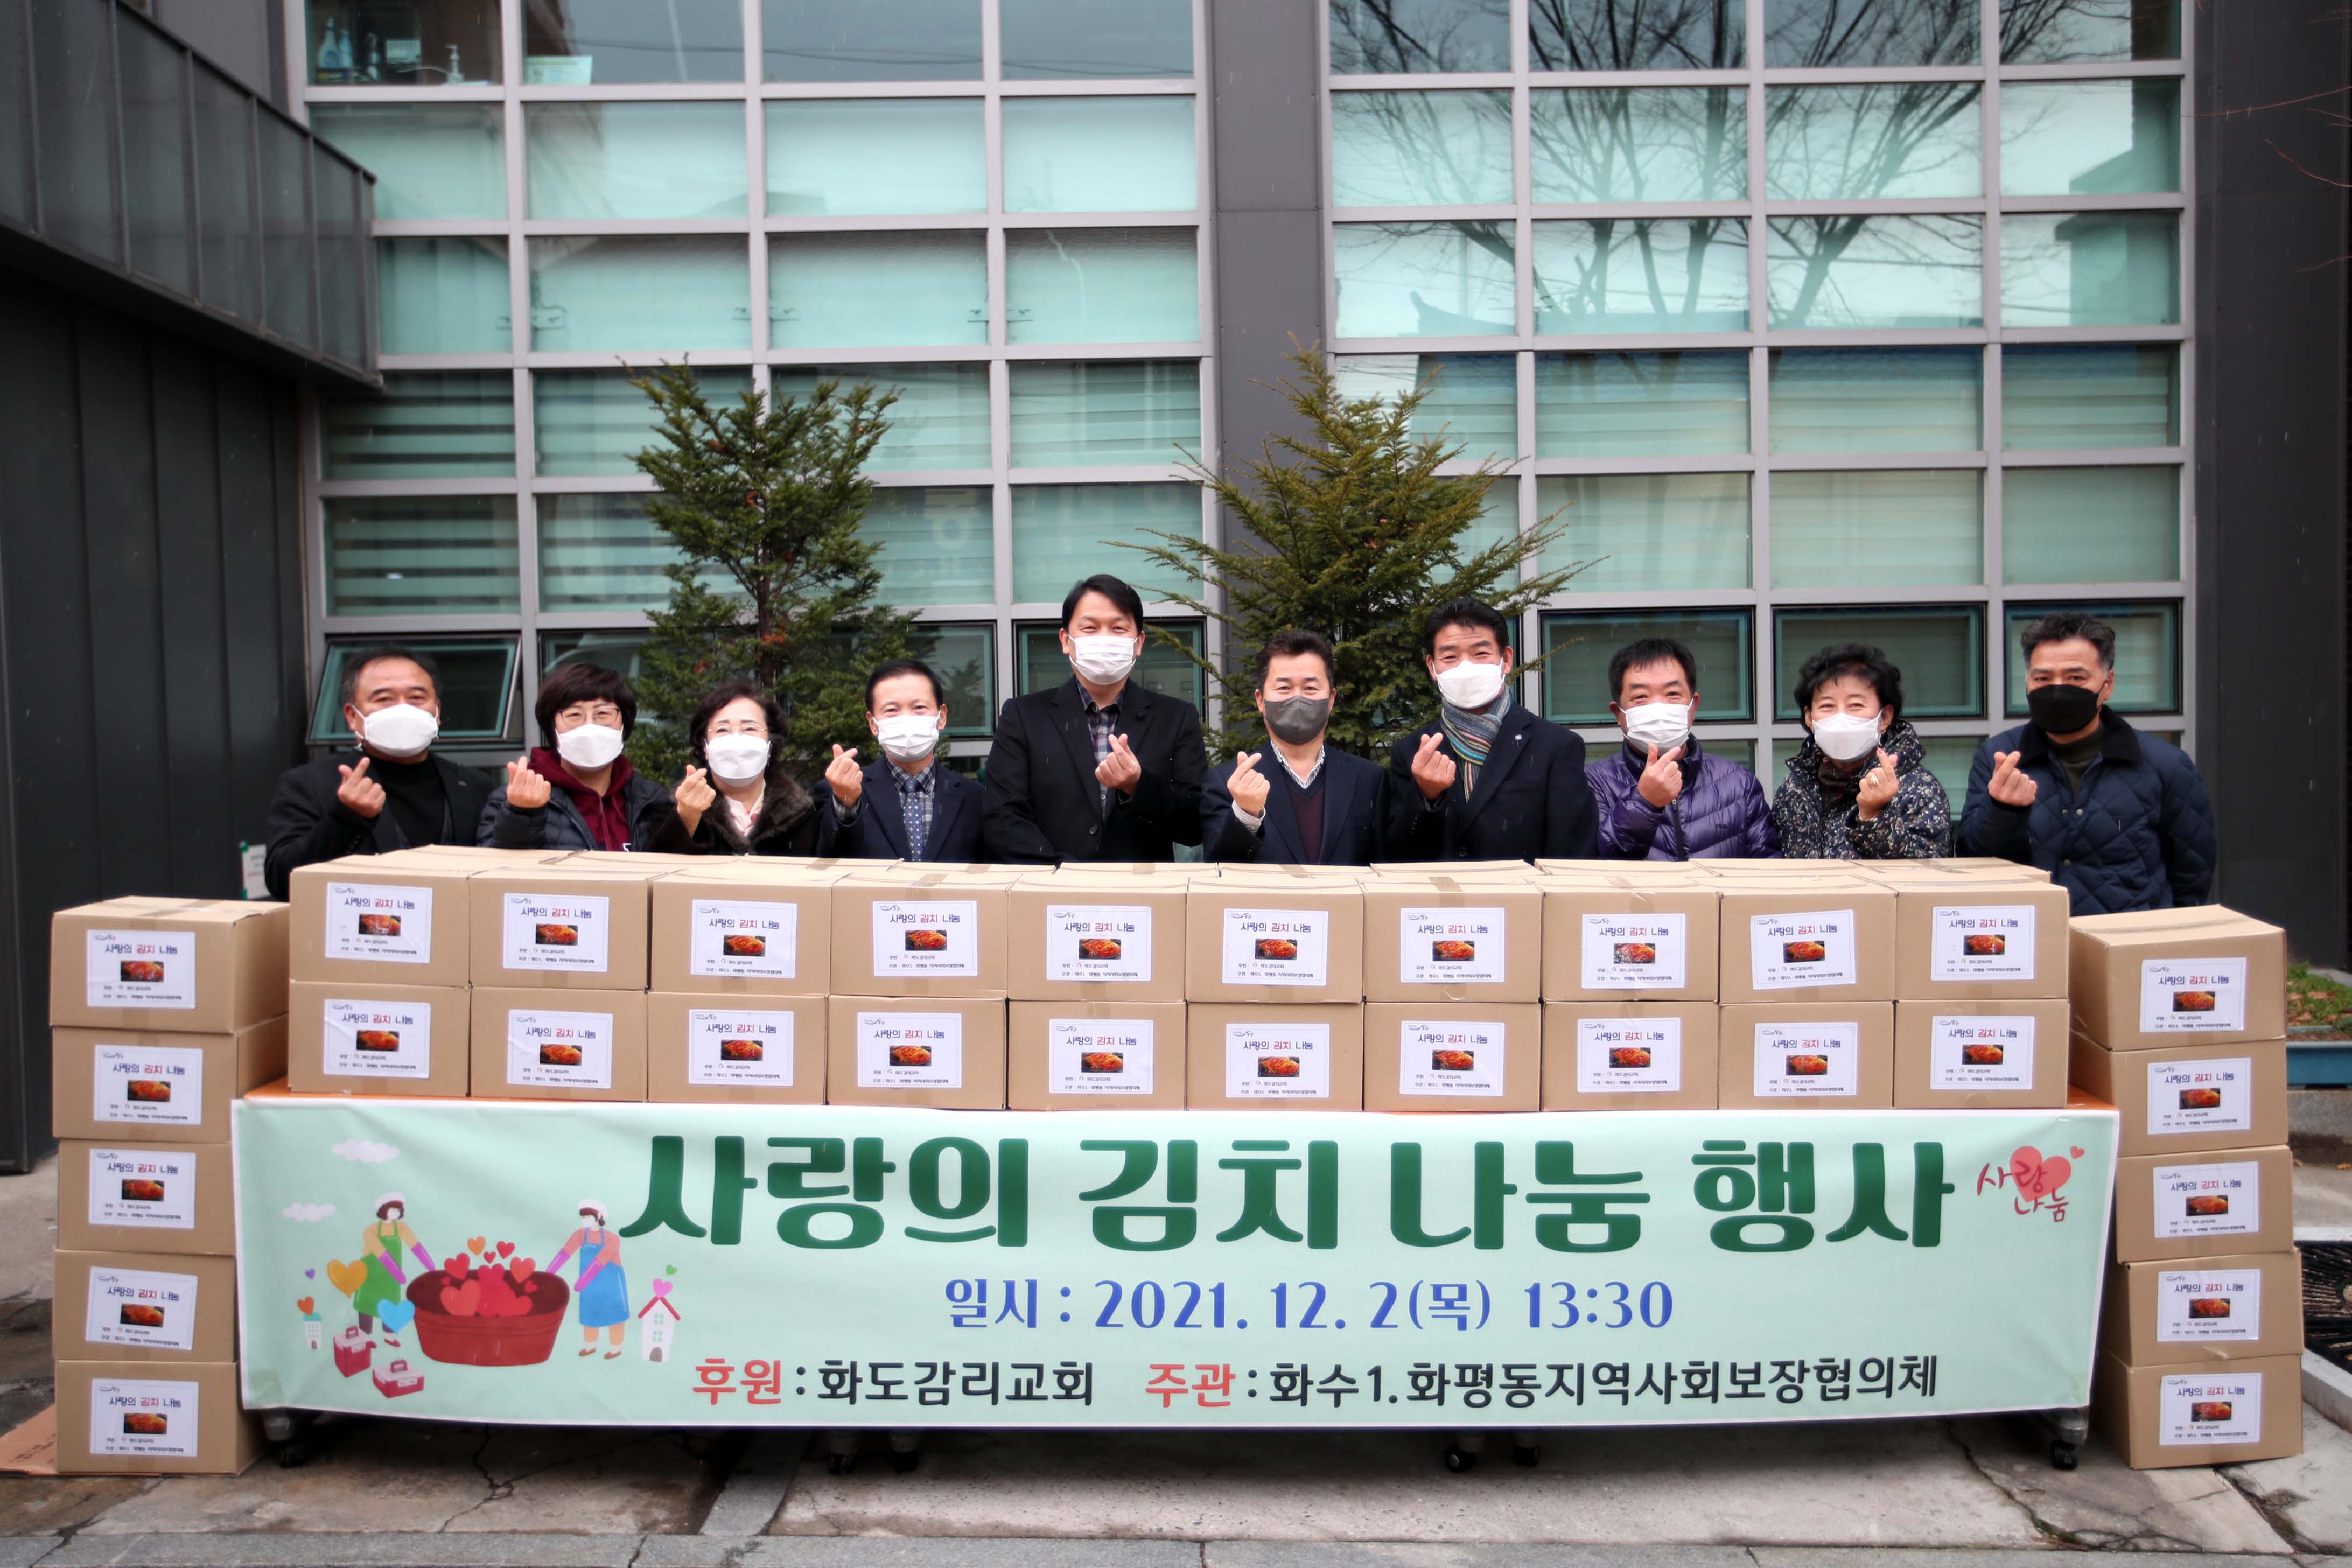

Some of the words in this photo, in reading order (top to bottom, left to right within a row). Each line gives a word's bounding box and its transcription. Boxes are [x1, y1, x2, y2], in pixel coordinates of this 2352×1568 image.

[345, 897, 370, 907] 사랑의
[375, 899, 393, 908] 김치
[397, 900, 415, 909] 나눔
[521, 907, 547, 917] 사랑의
[552, 908, 569, 918] 김치
[575, 909, 592, 918] 나눔
[890, 914, 915, 923] 사랑의
[921, 914, 937, 923] 김치
[943, 914, 960, 923] 나눔
[1949, 919, 1975, 928] 사랑의
[1979, 919, 1996, 928] 김치
[2001, 919, 2018, 927] 나눔
[709, 919, 735, 928] 사랑의
[740, 920, 757, 928] 김치
[762, 920, 779, 929] 나눔
[1064, 923, 1090, 932] 사랑의
[1095, 923, 1112, 932] 김치
[1117, 923, 1135, 932] 나눔
[1241, 922, 1266, 932] 사랑의
[1272, 923, 1289, 932] 김치
[1293, 924, 1311, 933] 나눔
[1418, 925, 1443, 934] 사랑의
[1448, 925, 1465, 934] 김치
[1471, 925, 1488, 933] 나눔
[1599, 927, 1625, 936] 사랑의
[1630, 927, 1647, 936] 김치
[1651, 927, 1668, 936] 나눔
[1768, 926, 1793, 936] 사랑의
[1798, 925, 1815, 935] 김치
[1820, 924, 1837, 933] 나눔
[106, 944, 132, 954] 사랑의
[137, 944, 155, 954] 김치
[159, 946, 178, 954] 나눔
[2159, 976, 2185, 985] 사랑의
[2189, 976, 2207, 985] 김치
[2211, 976, 2229, 984] 나눔
[342, 1013, 368, 1023] 사랑의
[373, 1014, 391, 1023] 김치
[395, 1016, 413, 1024] 나눔
[526, 1027, 551, 1037] 사랑의
[556, 1028, 573, 1038] 김치
[578, 1030, 596, 1039] 나눔
[706, 1024, 732, 1033] 사랑의
[737, 1024, 754, 1033] 김치
[759, 1025, 776, 1034] 나눔
[1948, 1029, 1973, 1038] 사랑의
[1978, 1029, 1995, 1038] 김치
[2000, 1029, 2017, 1038] 나눔
[874, 1030, 900, 1039] 사랑의
[905, 1030, 922, 1038] 김치
[927, 1030, 944, 1039] 나눔
[1418, 1034, 1444, 1043] 사랑의
[1448, 1035, 1465, 1043] 김치
[1471, 1035, 1487, 1044] 나눔
[1594, 1032, 1620, 1041] 사랑의
[1625, 1032, 1642, 1040] 김치
[1647, 1032, 1664, 1040] 나눔
[1067, 1037, 1092, 1046] 사랑의
[1097, 1037, 1114, 1045] 김치
[1119, 1037, 1137, 1045] 나눔
[1243, 1041, 1269, 1051] 사랑의
[1274, 1041, 1291, 1049] 김치
[1296, 1041, 1313, 1050] 나눔
[1772, 1040, 1797, 1049] 사랑의
[1802, 1039, 1819, 1048] 김치
[1824, 1039, 1840, 1048] 나눔
[113, 1063, 139, 1073] 사랑의
[144, 1065, 162, 1074] 김치
[167, 1066, 185, 1075] 나눔
[2165, 1074, 2190, 1084] 사랑의
[2195, 1073, 2211, 1082] 김치
[2216, 1072, 2234, 1081] 나눔
[108, 1163, 134, 1172] 사랑의
[138, 1164, 156, 1173] 김치
[160, 1165, 178, 1174] 나눔
[1977, 1163, 2047, 1195] 사랑
[2171, 1181, 2196, 1191] 사랑의
[2201, 1180, 2218, 1189] 김치
[2223, 1180, 2241, 1188] 나눔
[619, 1136, 1028, 1249] 사랑의
[1079, 1141, 1338, 1251] 김치
[1391, 1142, 1650, 1252] 나눔
[1692, 1141, 1955, 1252] 행사
[2014, 1187, 2069, 1222] 나눔
[2175, 1284, 2201, 1293] 사랑의
[2206, 1284, 2222, 1292] 김치
[2227, 1283, 2243, 1291] 나눔
[107, 1287, 134, 1297] 사랑의
[139, 1289, 157, 1299] 김치
[162, 1292, 179, 1301] 나눔
[1271, 1282, 1345, 1329] 12.
[1370, 1281, 1490, 1330] 2(목)
[1525, 1282, 1672, 1328] 13:30
[2177, 1388, 2202, 1397] 사랑의
[2207, 1387, 2223, 1395] 김치
[2228, 1387, 2245, 1395] 나눔
[109, 1396, 136, 1406] 사랑의
[141, 1397, 159, 1406] 김치
[164, 1398, 181, 1408] 나눔
